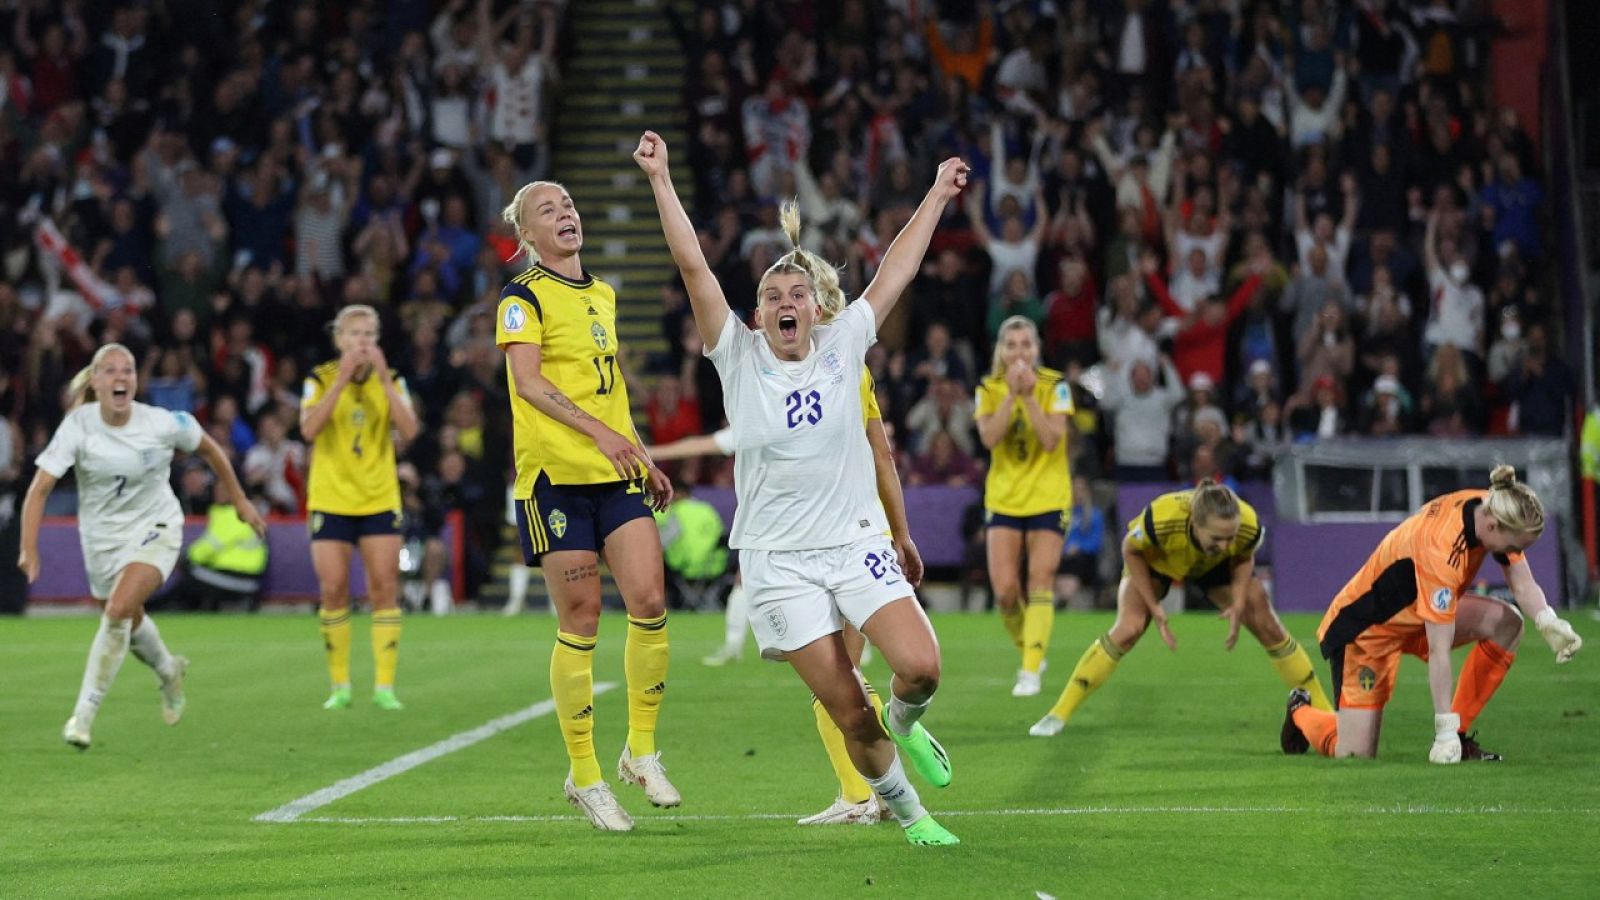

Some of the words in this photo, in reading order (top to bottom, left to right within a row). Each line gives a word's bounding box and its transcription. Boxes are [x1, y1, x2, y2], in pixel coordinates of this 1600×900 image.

[593, 356, 615, 394] 17
[786, 390, 823, 429] 23
[115, 475, 127, 497] 7
